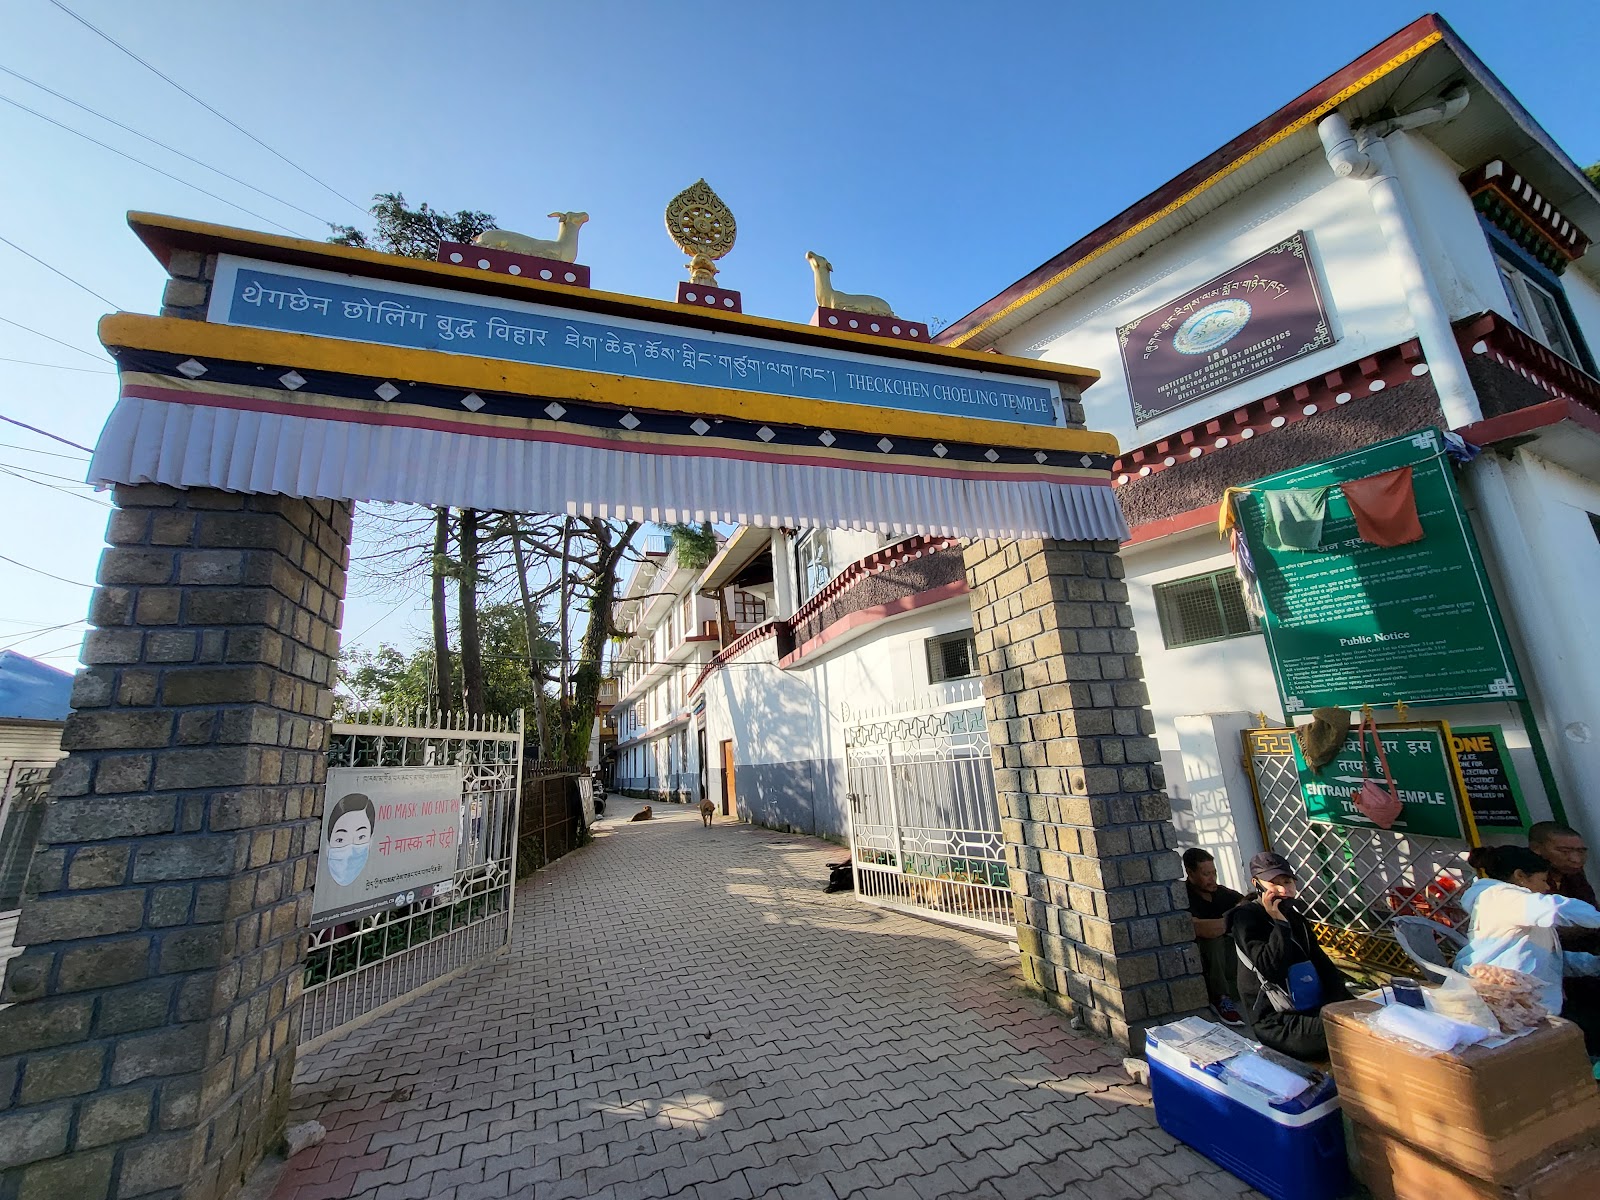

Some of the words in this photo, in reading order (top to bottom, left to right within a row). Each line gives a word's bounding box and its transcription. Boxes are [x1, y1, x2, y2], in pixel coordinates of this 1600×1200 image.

[242, 280, 332, 316] थेगछेन
[342, 297, 427, 330] छोलिंग
[437, 316, 477, 340] बुद्ध
[486, 318, 548, 347] विहार
[1157, 374, 1192, 393] INSTITUTE
[1194, 369, 1203, 377] OF
[1205, 352, 1242, 373] BUDDHIST
[1243, 330, 1291, 355] DIALECTICS
[1251, 356, 1274, 369] India
[847, 373, 930, 398] THECKCHEN
[933, 384, 998, 407] CHOELING
[1000, 393, 1049, 413] TEMPLE
[1344, 537, 1365, 548] सूच
[1339, 635, 1372, 647] Public
[1373, 632, 1410, 643] Notice
[1405, 740, 1432, 757] इस
[1452, 736, 1493, 752] ONE
[1306, 783, 1363, 798] ENTRANC
[1388, 789, 1447, 805] EMPLE
[379, 804, 393, 820] NO
[395, 802, 418, 820] MASK
[421, 801, 432, 816] NO
[379, 836, 392, 857] नो
[394, 836, 423, 853] मास्क
[426, 829, 436, 847] नो
[438, 826, 455, 848] एंट्री
